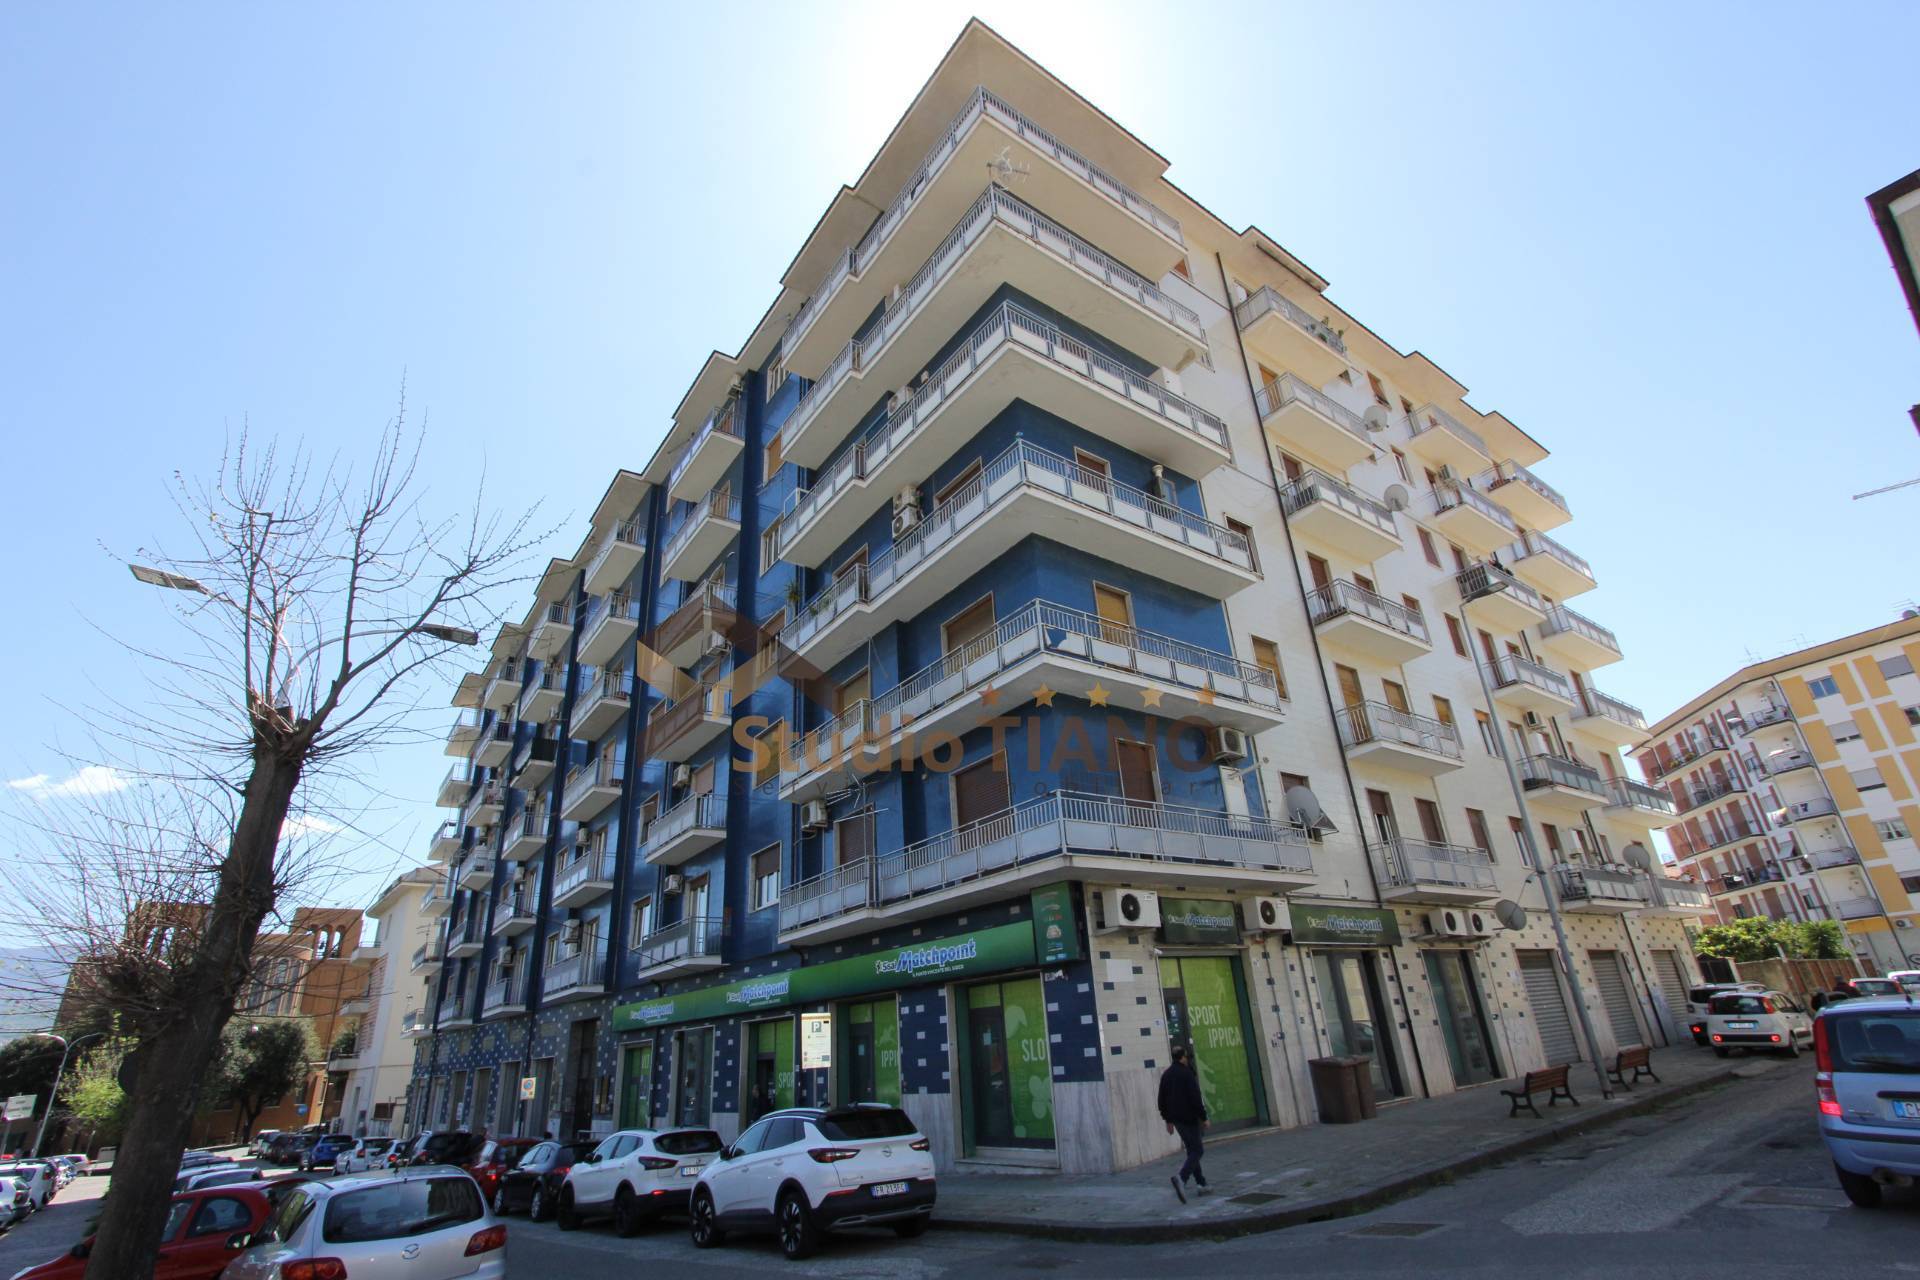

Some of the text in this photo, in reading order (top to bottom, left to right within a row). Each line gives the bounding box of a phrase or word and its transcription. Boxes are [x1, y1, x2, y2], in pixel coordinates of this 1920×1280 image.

[896, 937, 977, 974] Matchpoint
[1188, 1005, 1222, 1026] SPORT
[1208, 1026, 1243, 1049] IPPICA
[881, 1049, 898, 1068] IPPI
